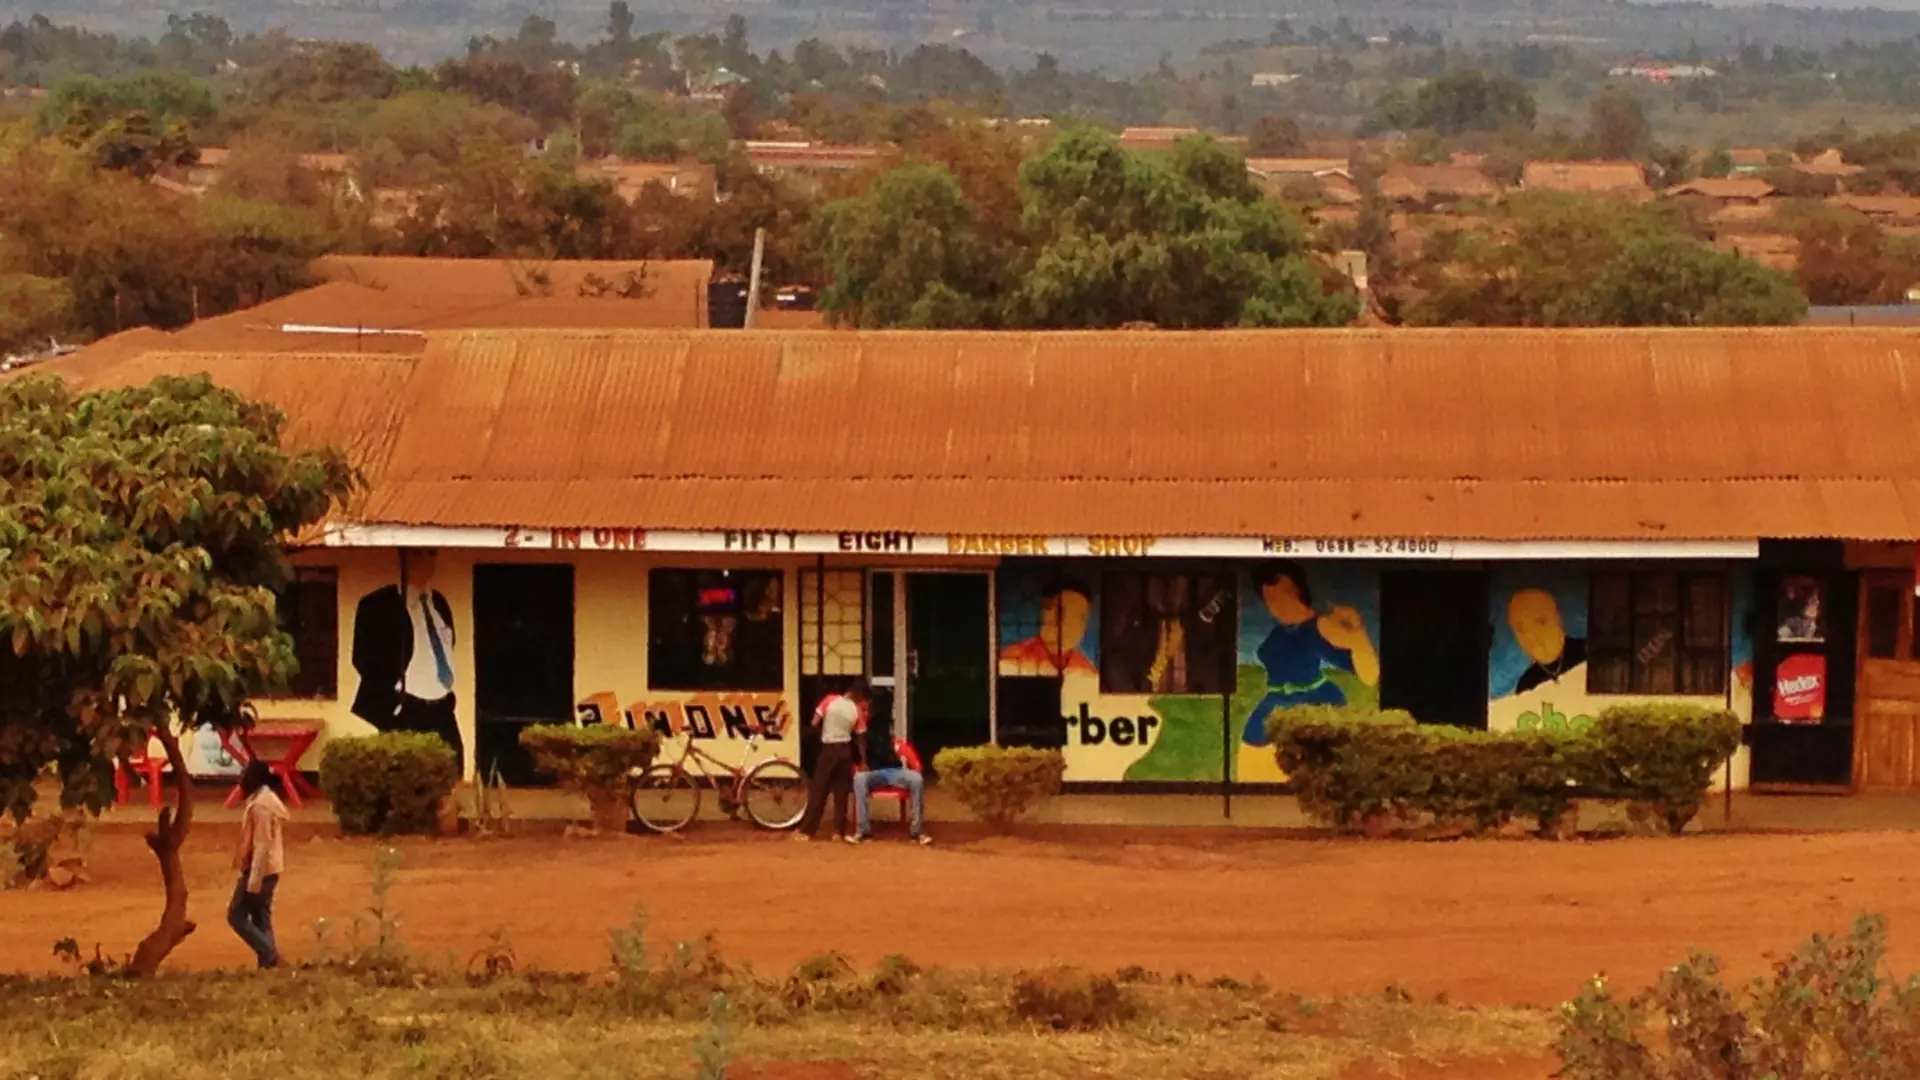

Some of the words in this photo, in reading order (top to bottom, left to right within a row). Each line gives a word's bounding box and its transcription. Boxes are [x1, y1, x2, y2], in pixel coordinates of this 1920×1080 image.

[550, 527, 581, 549] IN
[593, 527, 646, 549] ONE
[724, 529, 798, 550] FIFTY
[839, 530, 916, 551] EIGHT
[1087, 534, 1158, 556] SHOP
